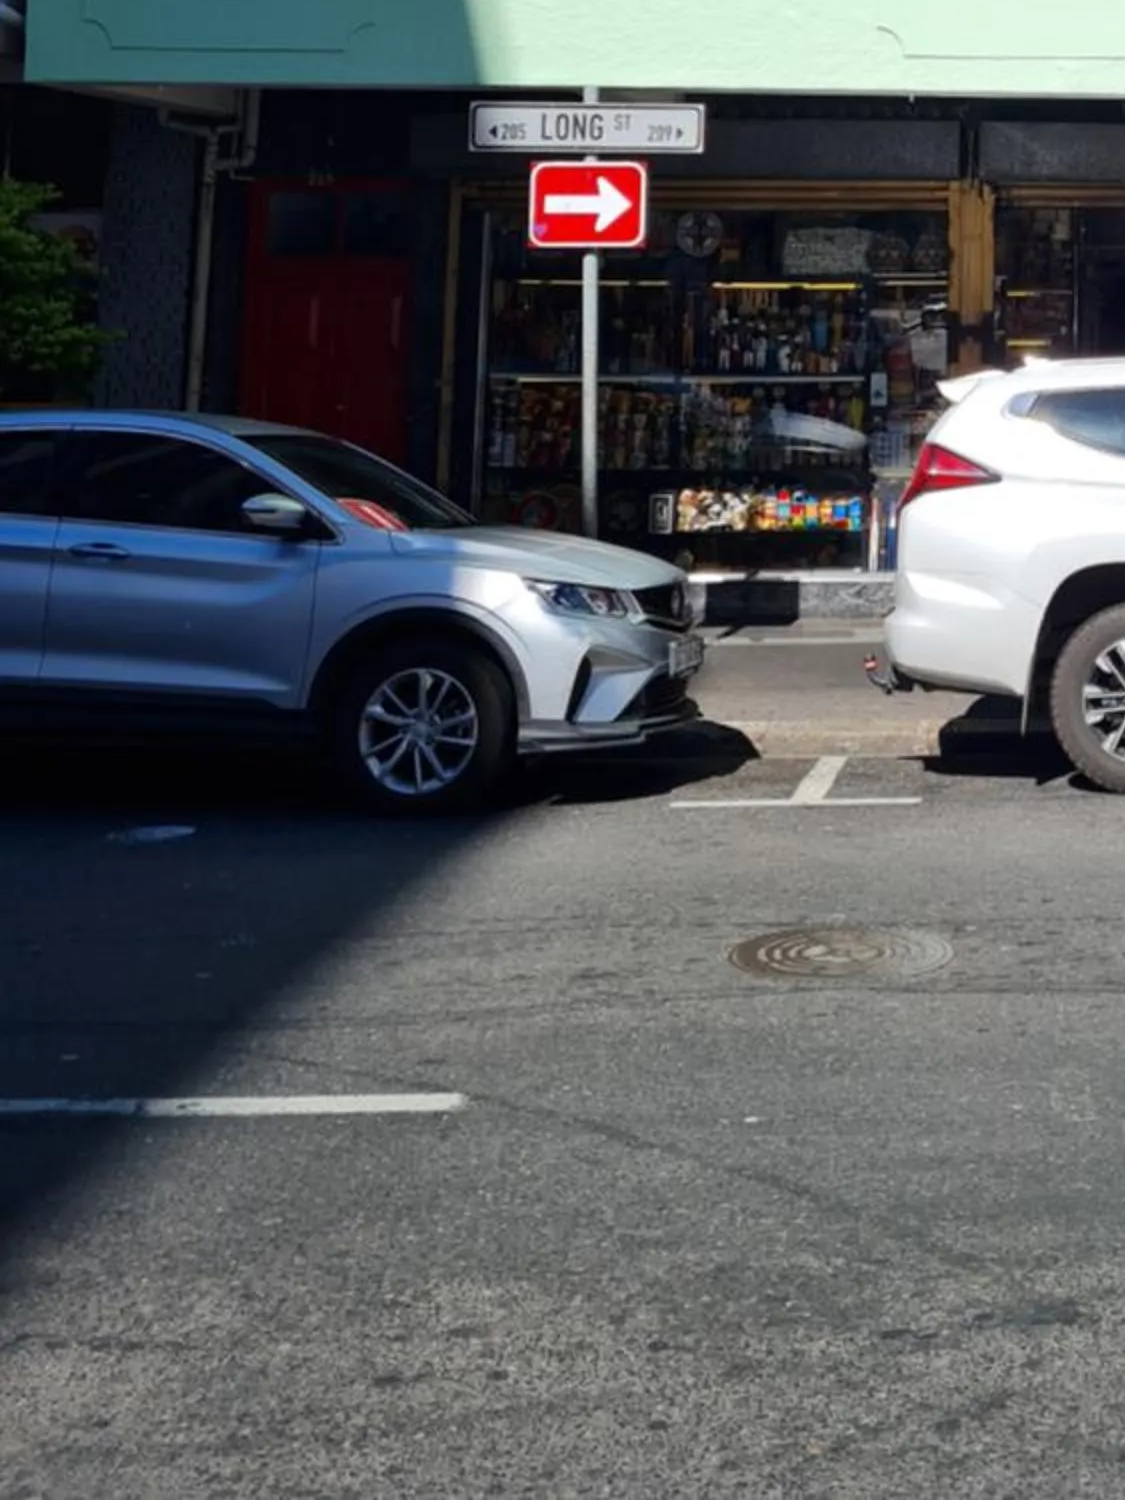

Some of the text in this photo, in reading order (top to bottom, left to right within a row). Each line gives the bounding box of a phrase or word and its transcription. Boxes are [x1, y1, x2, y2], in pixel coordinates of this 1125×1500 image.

[501, 124, 527, 140] 205
[541, 113, 604, 140] LONG
[613, 114, 632, 131] ST
